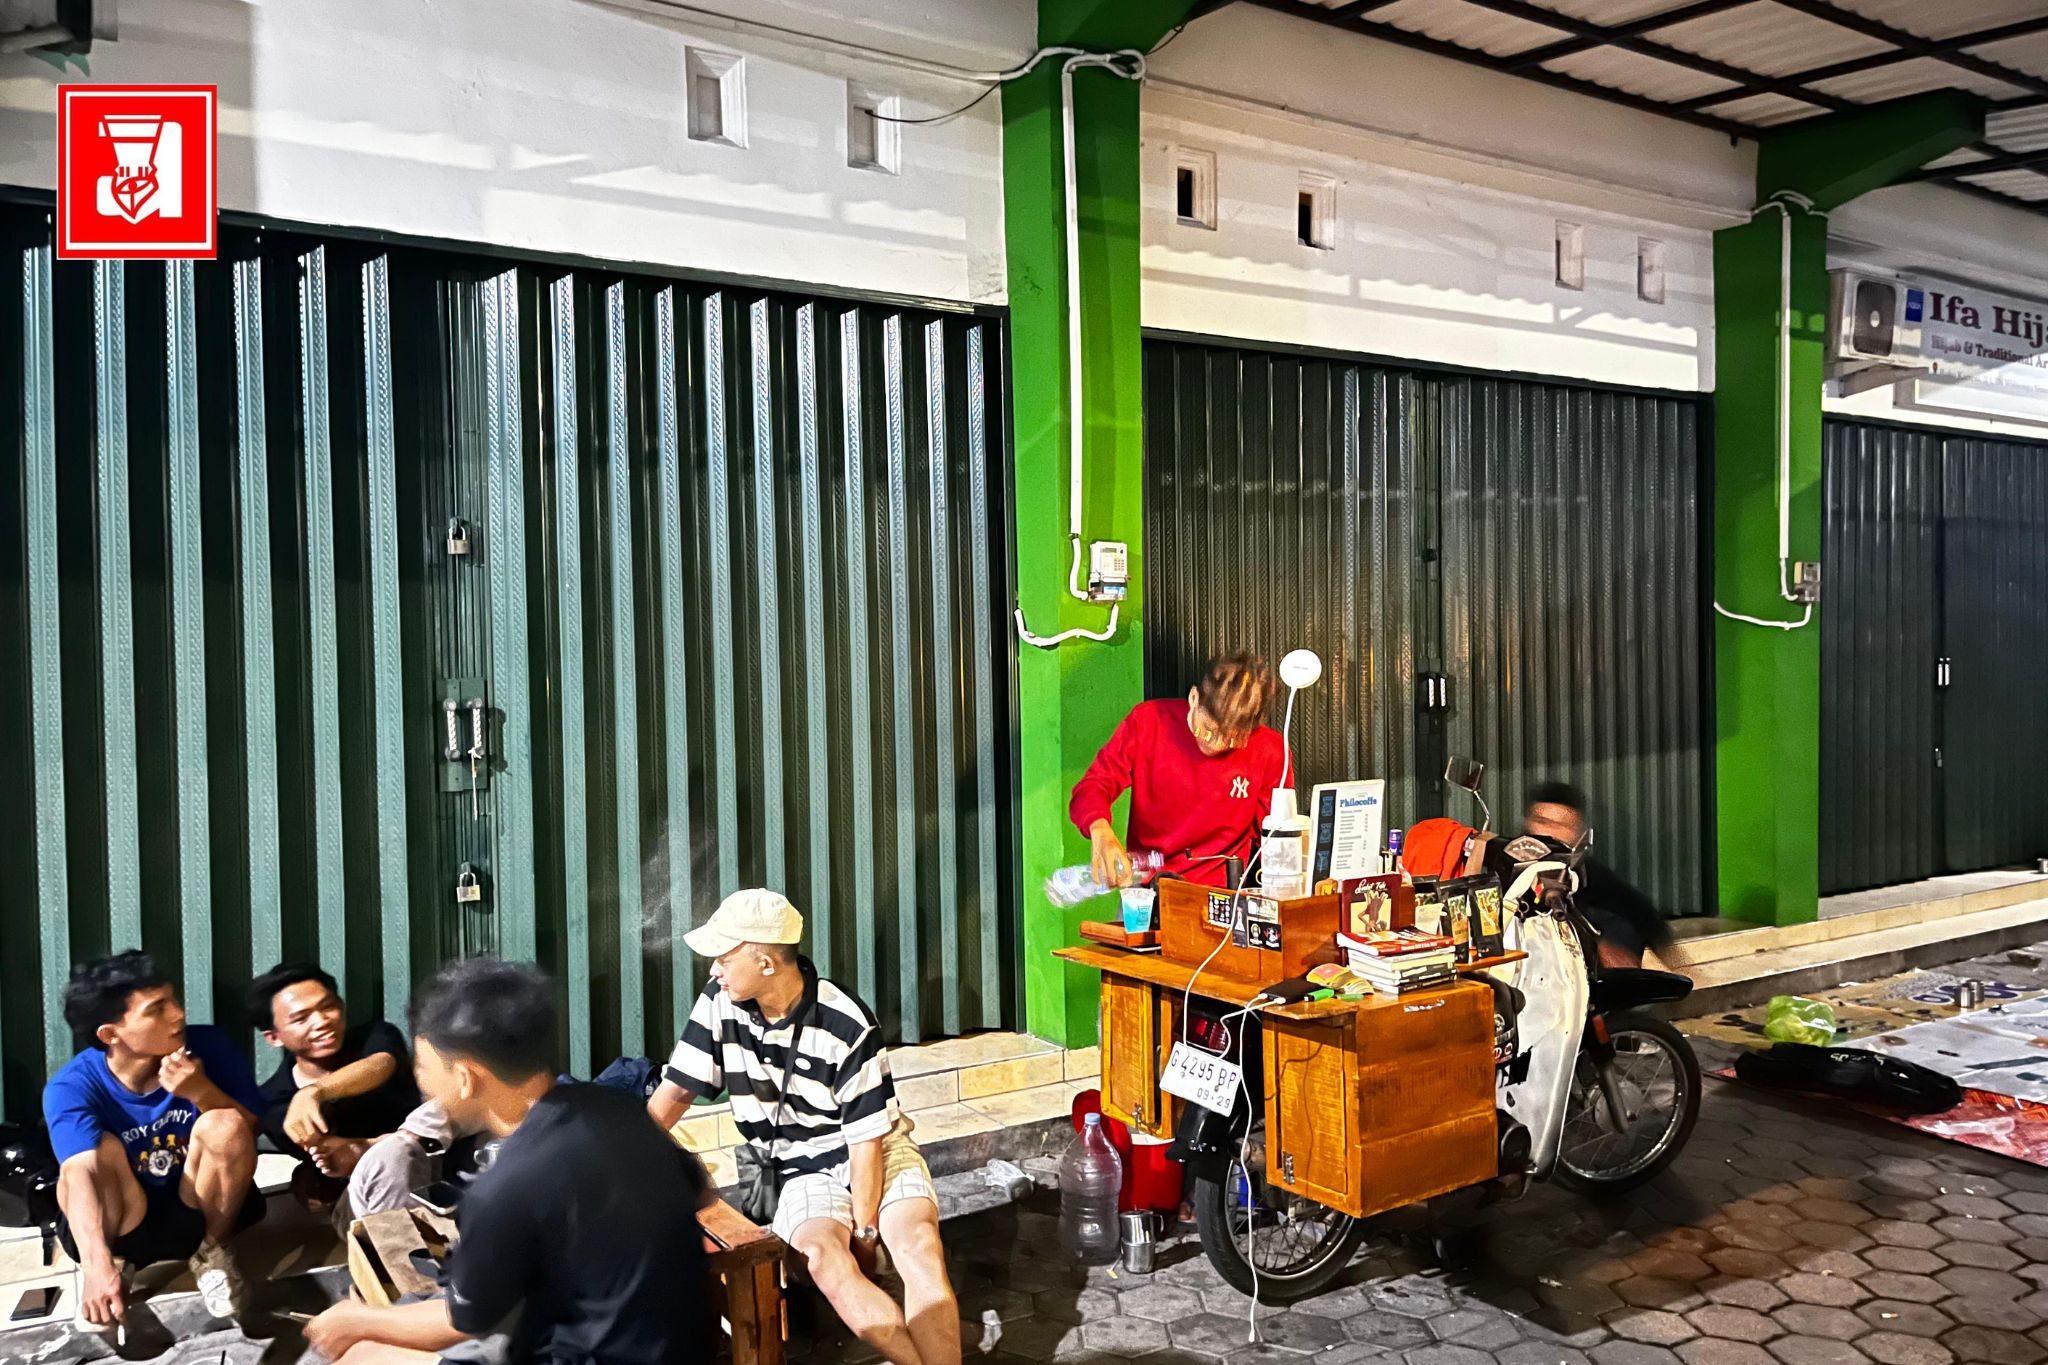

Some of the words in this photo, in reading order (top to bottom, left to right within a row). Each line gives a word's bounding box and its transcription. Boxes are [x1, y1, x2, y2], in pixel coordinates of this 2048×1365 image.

[1929, 292, 1981, 329] Ifa
[1963, 341, 1974, 354] &
[1975, 344, 2033, 367] Traditional
[1229, 776, 1250, 799] NY
[1171, 1050, 1180, 1067] G
[1181, 1055, 1214, 1081] 4295
[1218, 1068, 1237, 1090] BP
